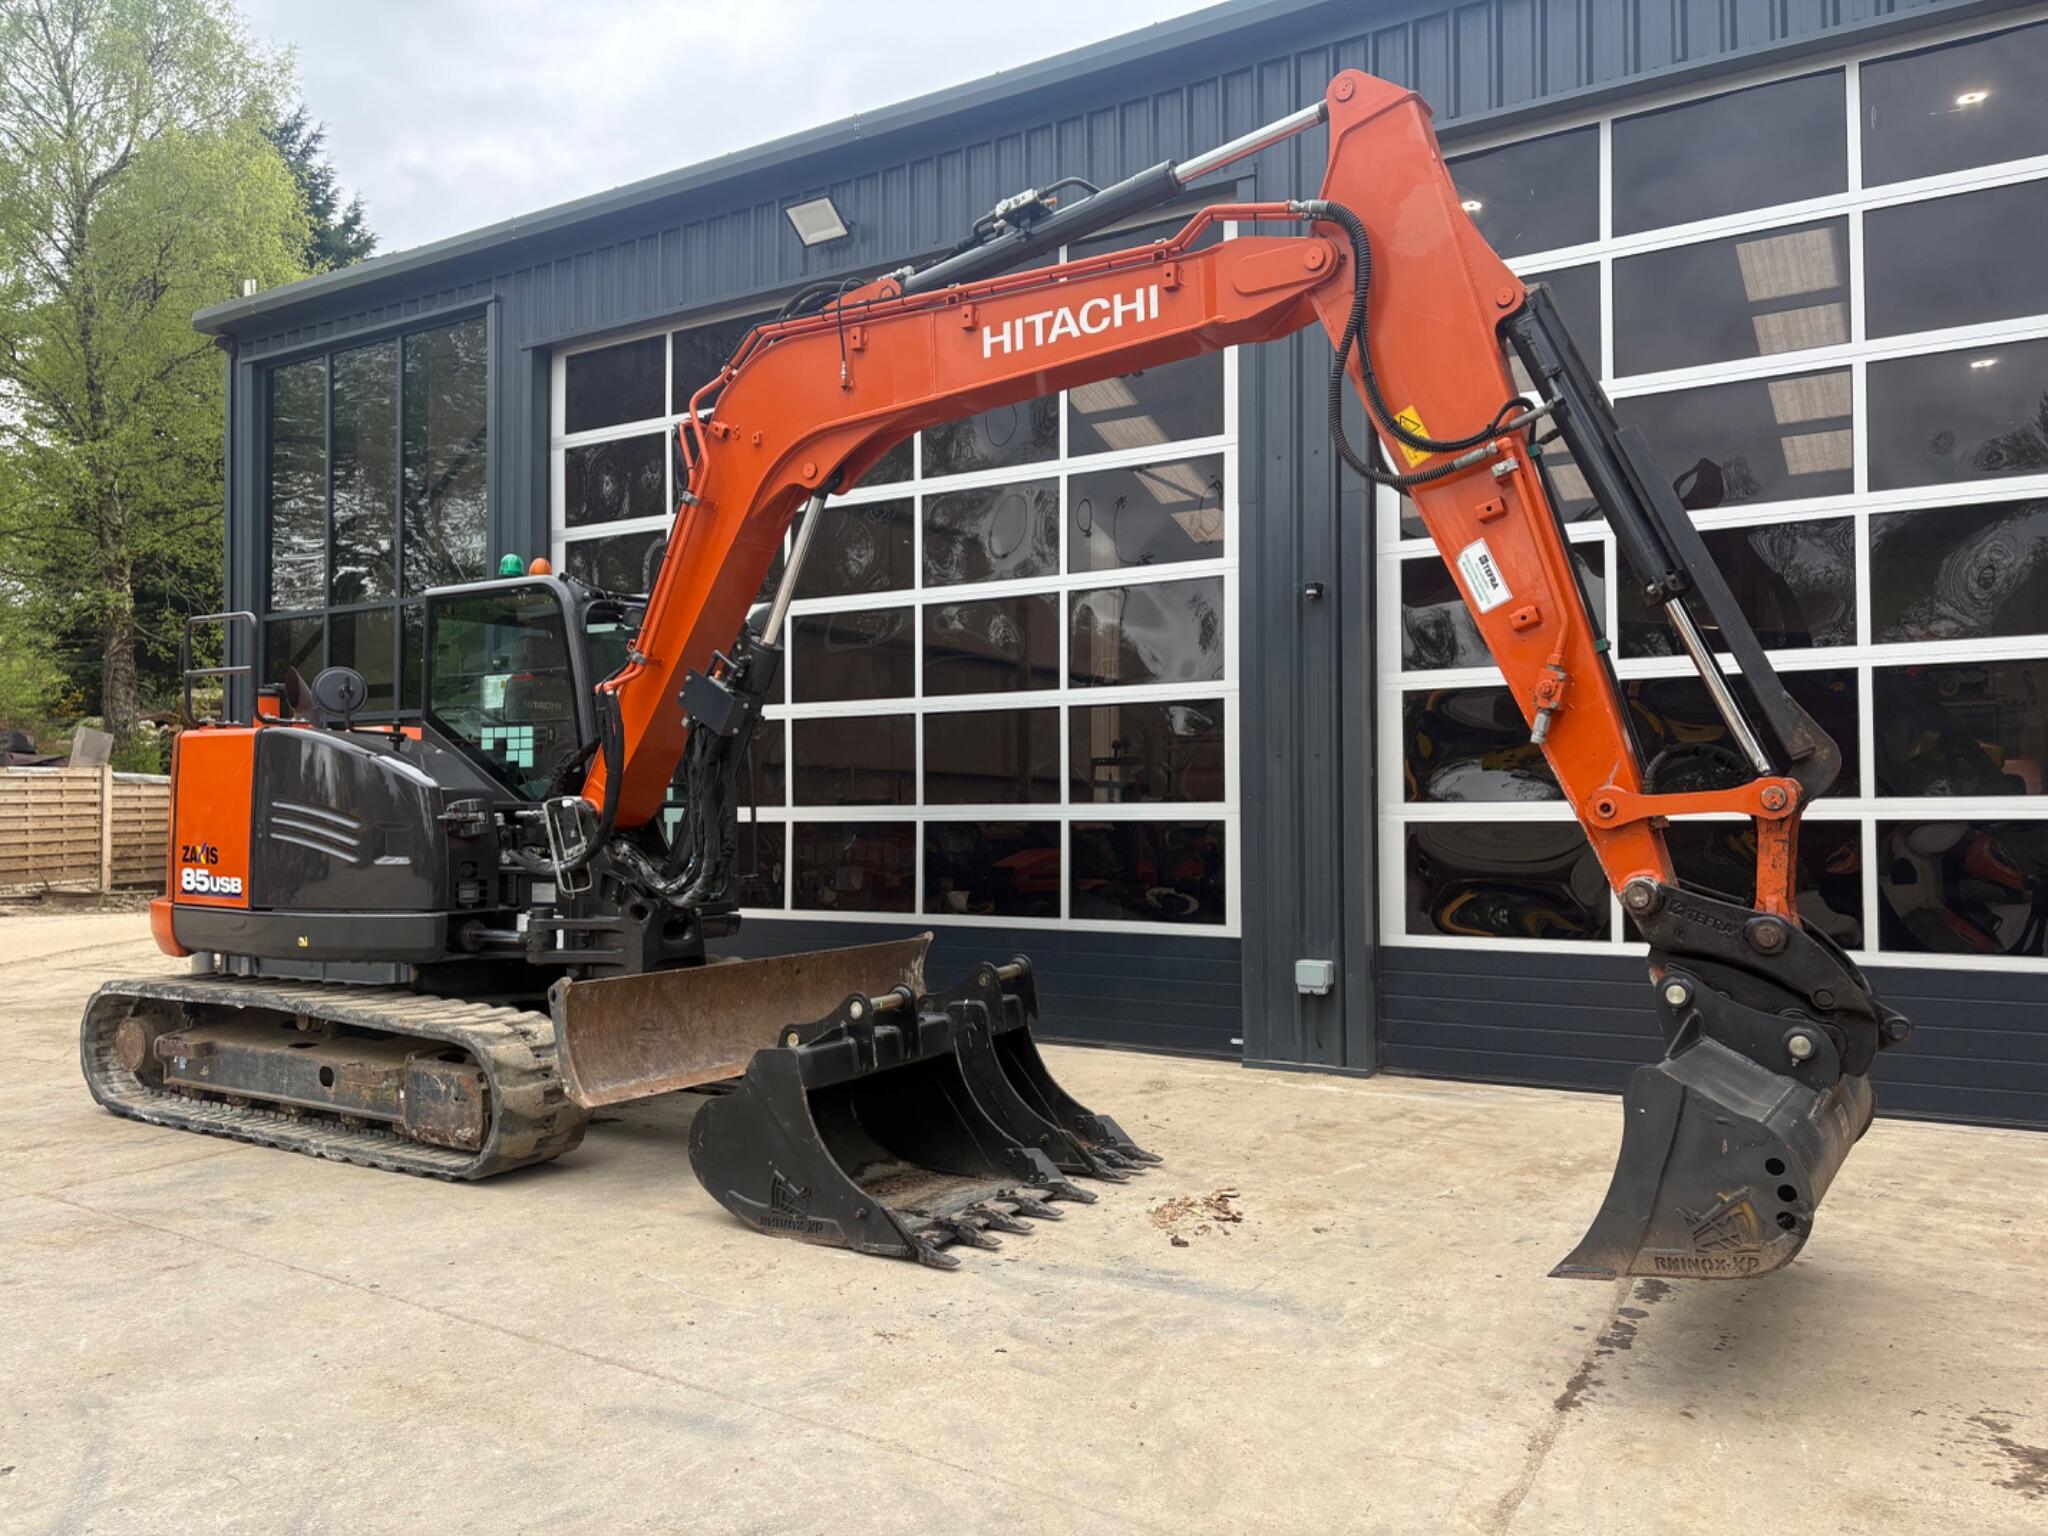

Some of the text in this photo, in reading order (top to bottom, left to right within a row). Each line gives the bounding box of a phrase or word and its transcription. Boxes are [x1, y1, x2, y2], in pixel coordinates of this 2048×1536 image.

[982, 284, 1159, 359] HITACHI
[1483, 564, 1500, 590] TEFRA
[182, 840, 219, 864] ZAXIS
[181, 867, 242, 894] 85USB
[1654, 1256, 1760, 1273] RHINOX-XP
